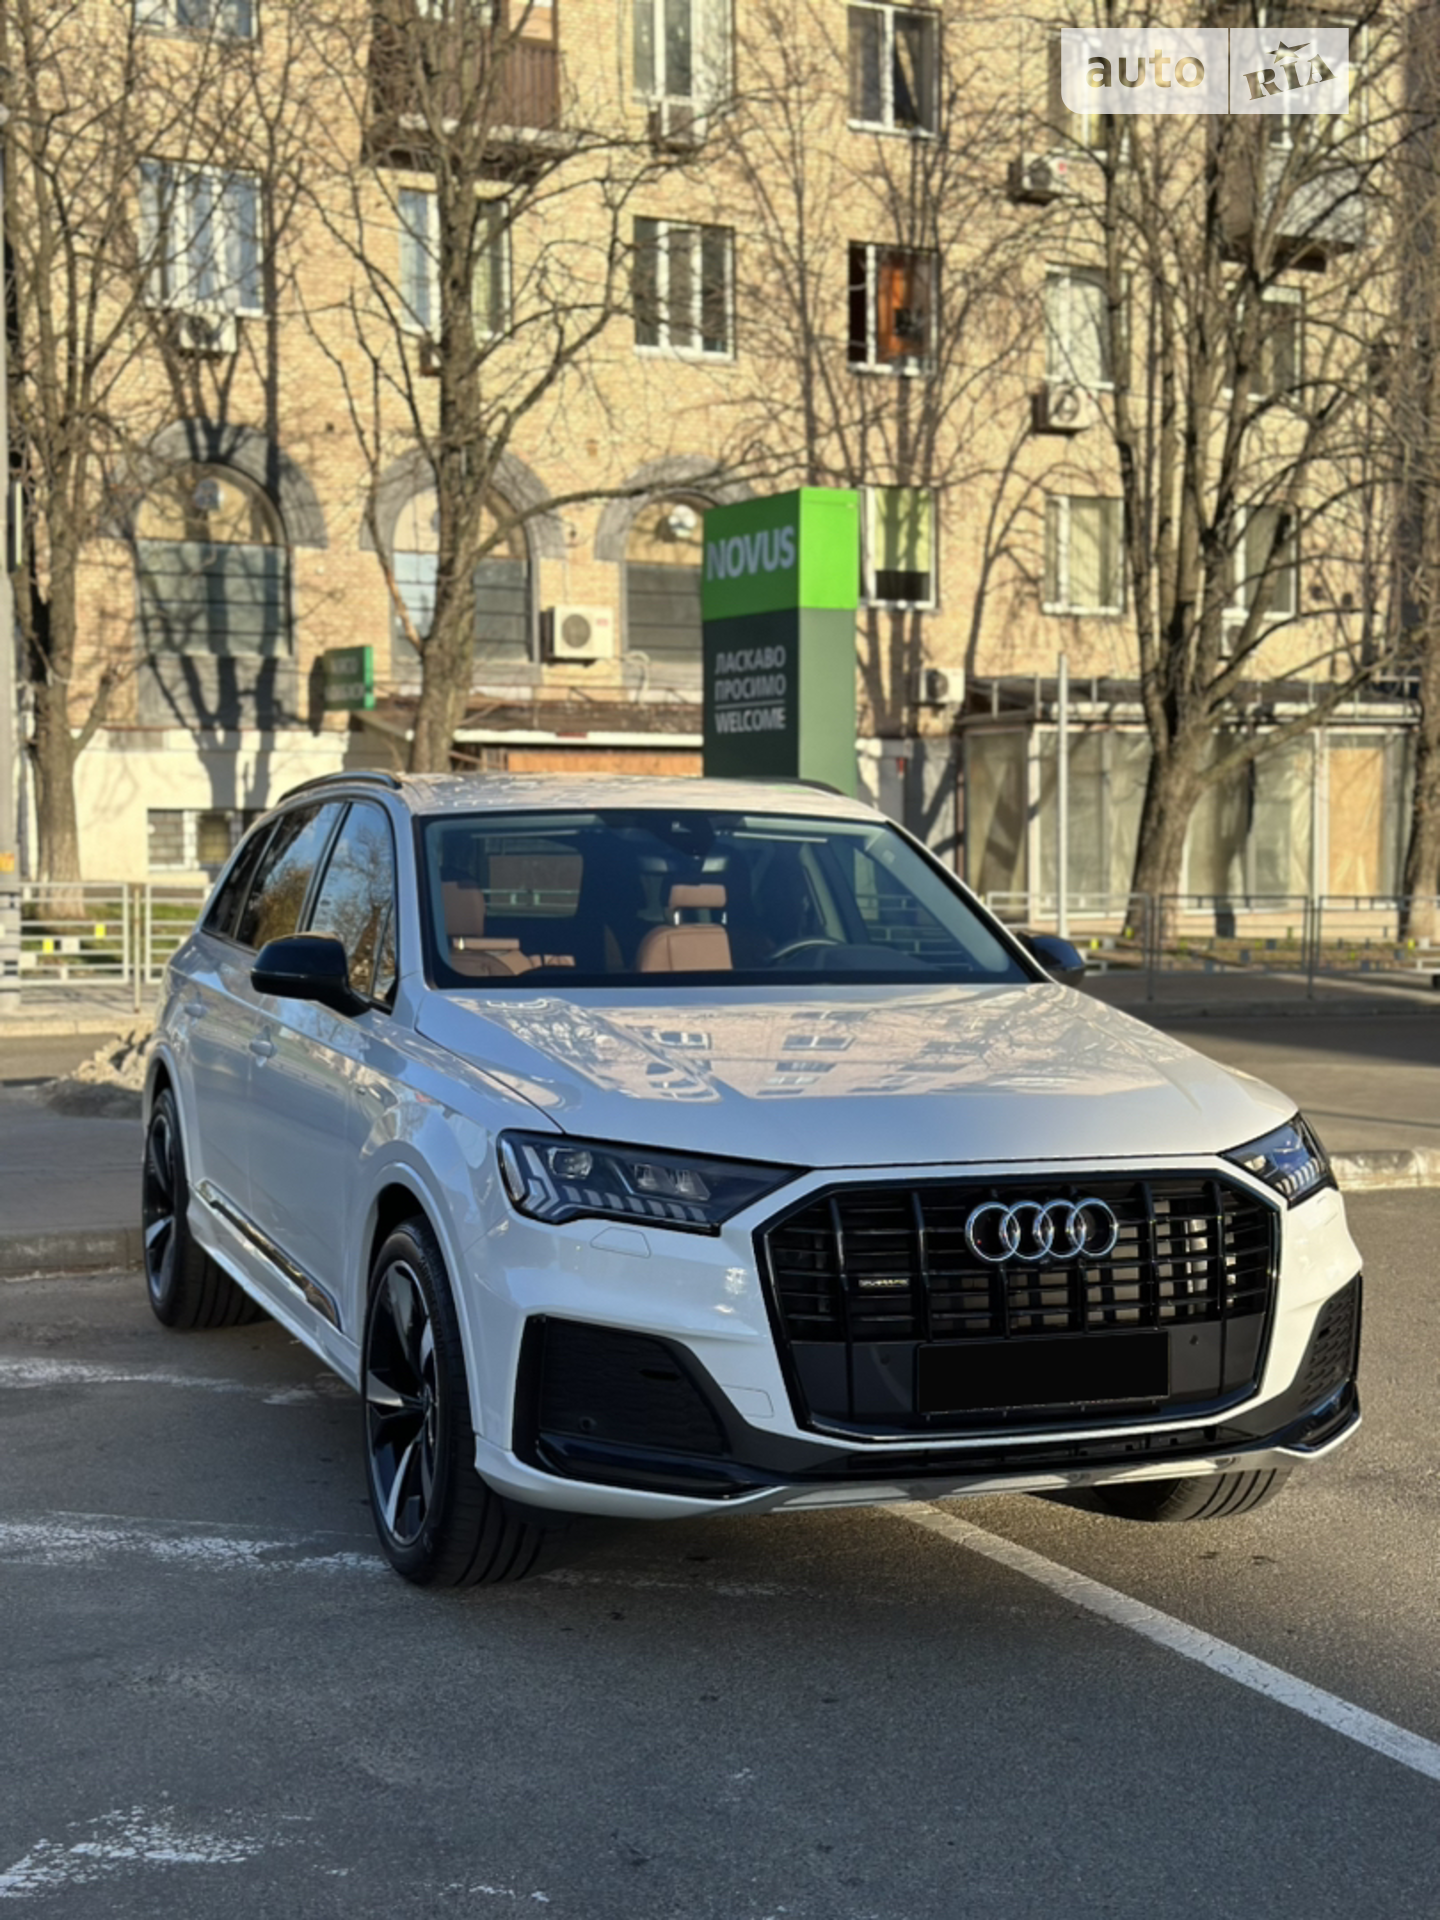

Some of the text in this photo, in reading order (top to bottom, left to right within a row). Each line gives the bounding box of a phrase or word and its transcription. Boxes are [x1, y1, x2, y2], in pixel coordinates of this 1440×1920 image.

[706, 525, 796, 582] NOVUS
[715, 645, 786, 675] ЛАСКАВО
[715, 674, 787, 702] ПРОСИМО
[714, 707, 786, 734] WELCOME
